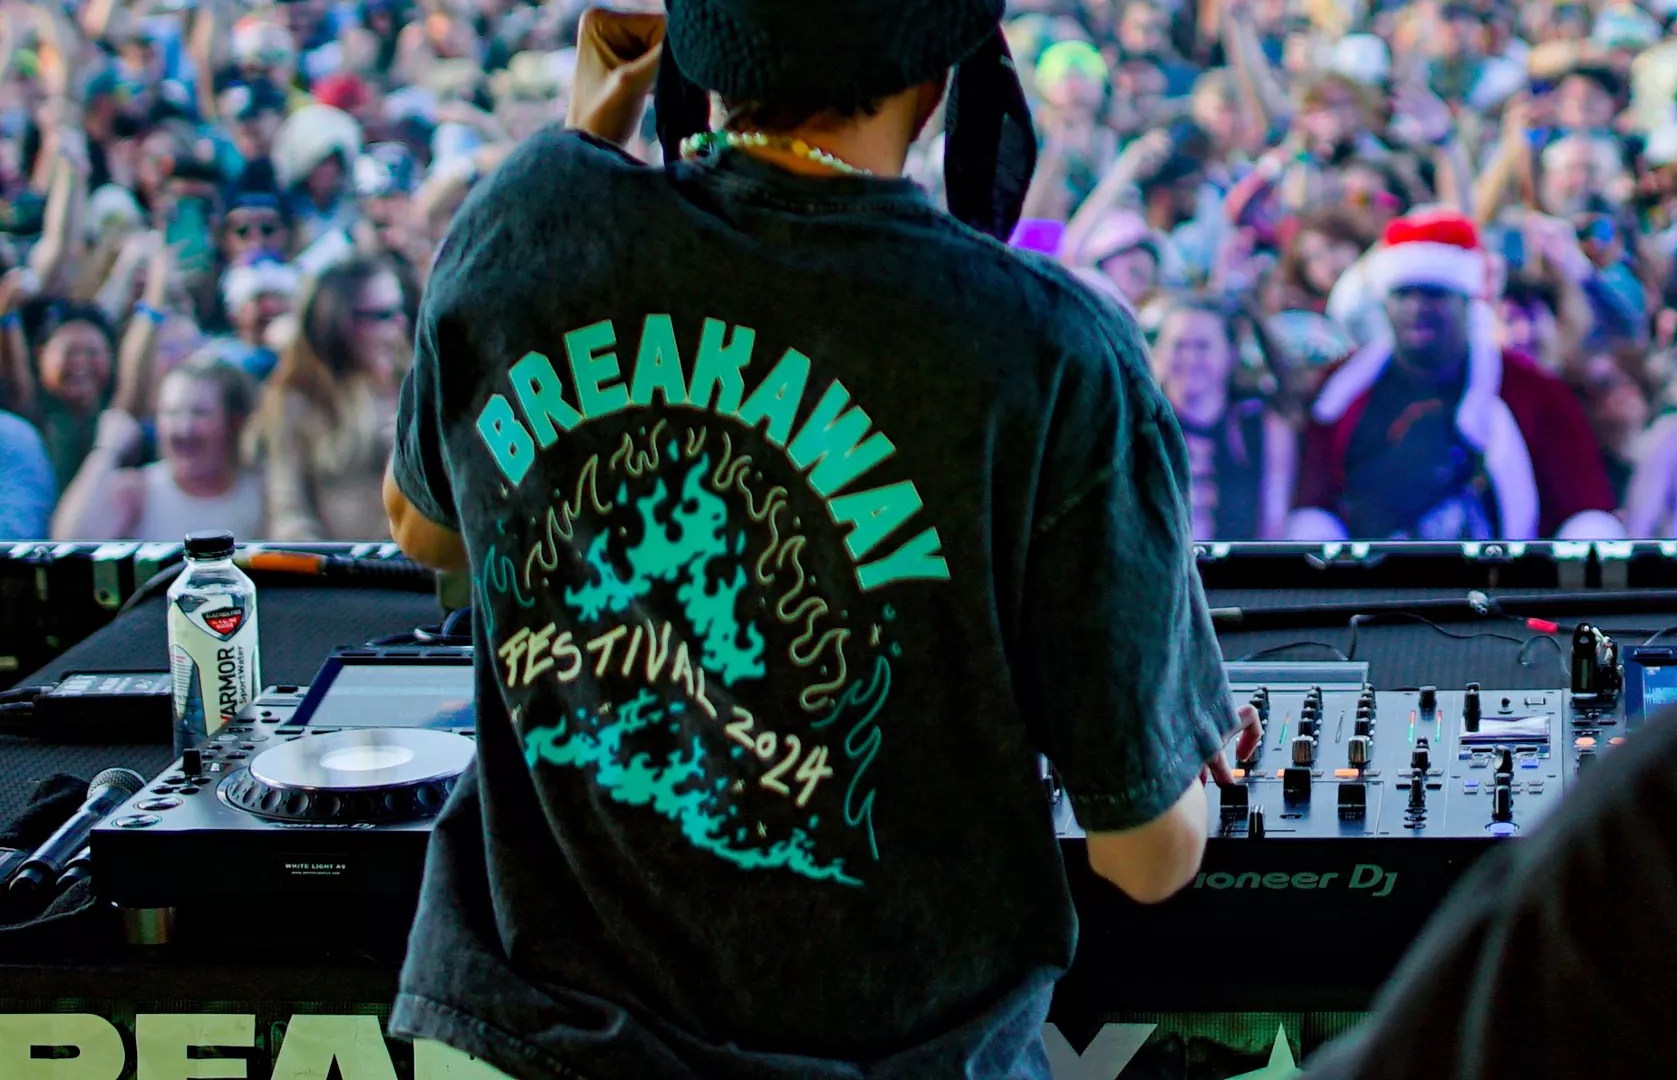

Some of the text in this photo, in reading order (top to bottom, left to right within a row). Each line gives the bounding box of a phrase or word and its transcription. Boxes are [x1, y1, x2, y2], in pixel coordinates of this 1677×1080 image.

[475, 313, 951, 591] BREAKAWAY
[498, 620, 834, 807] FESTIVAL 2024
[1194, 871, 1339, 890] ioneer
